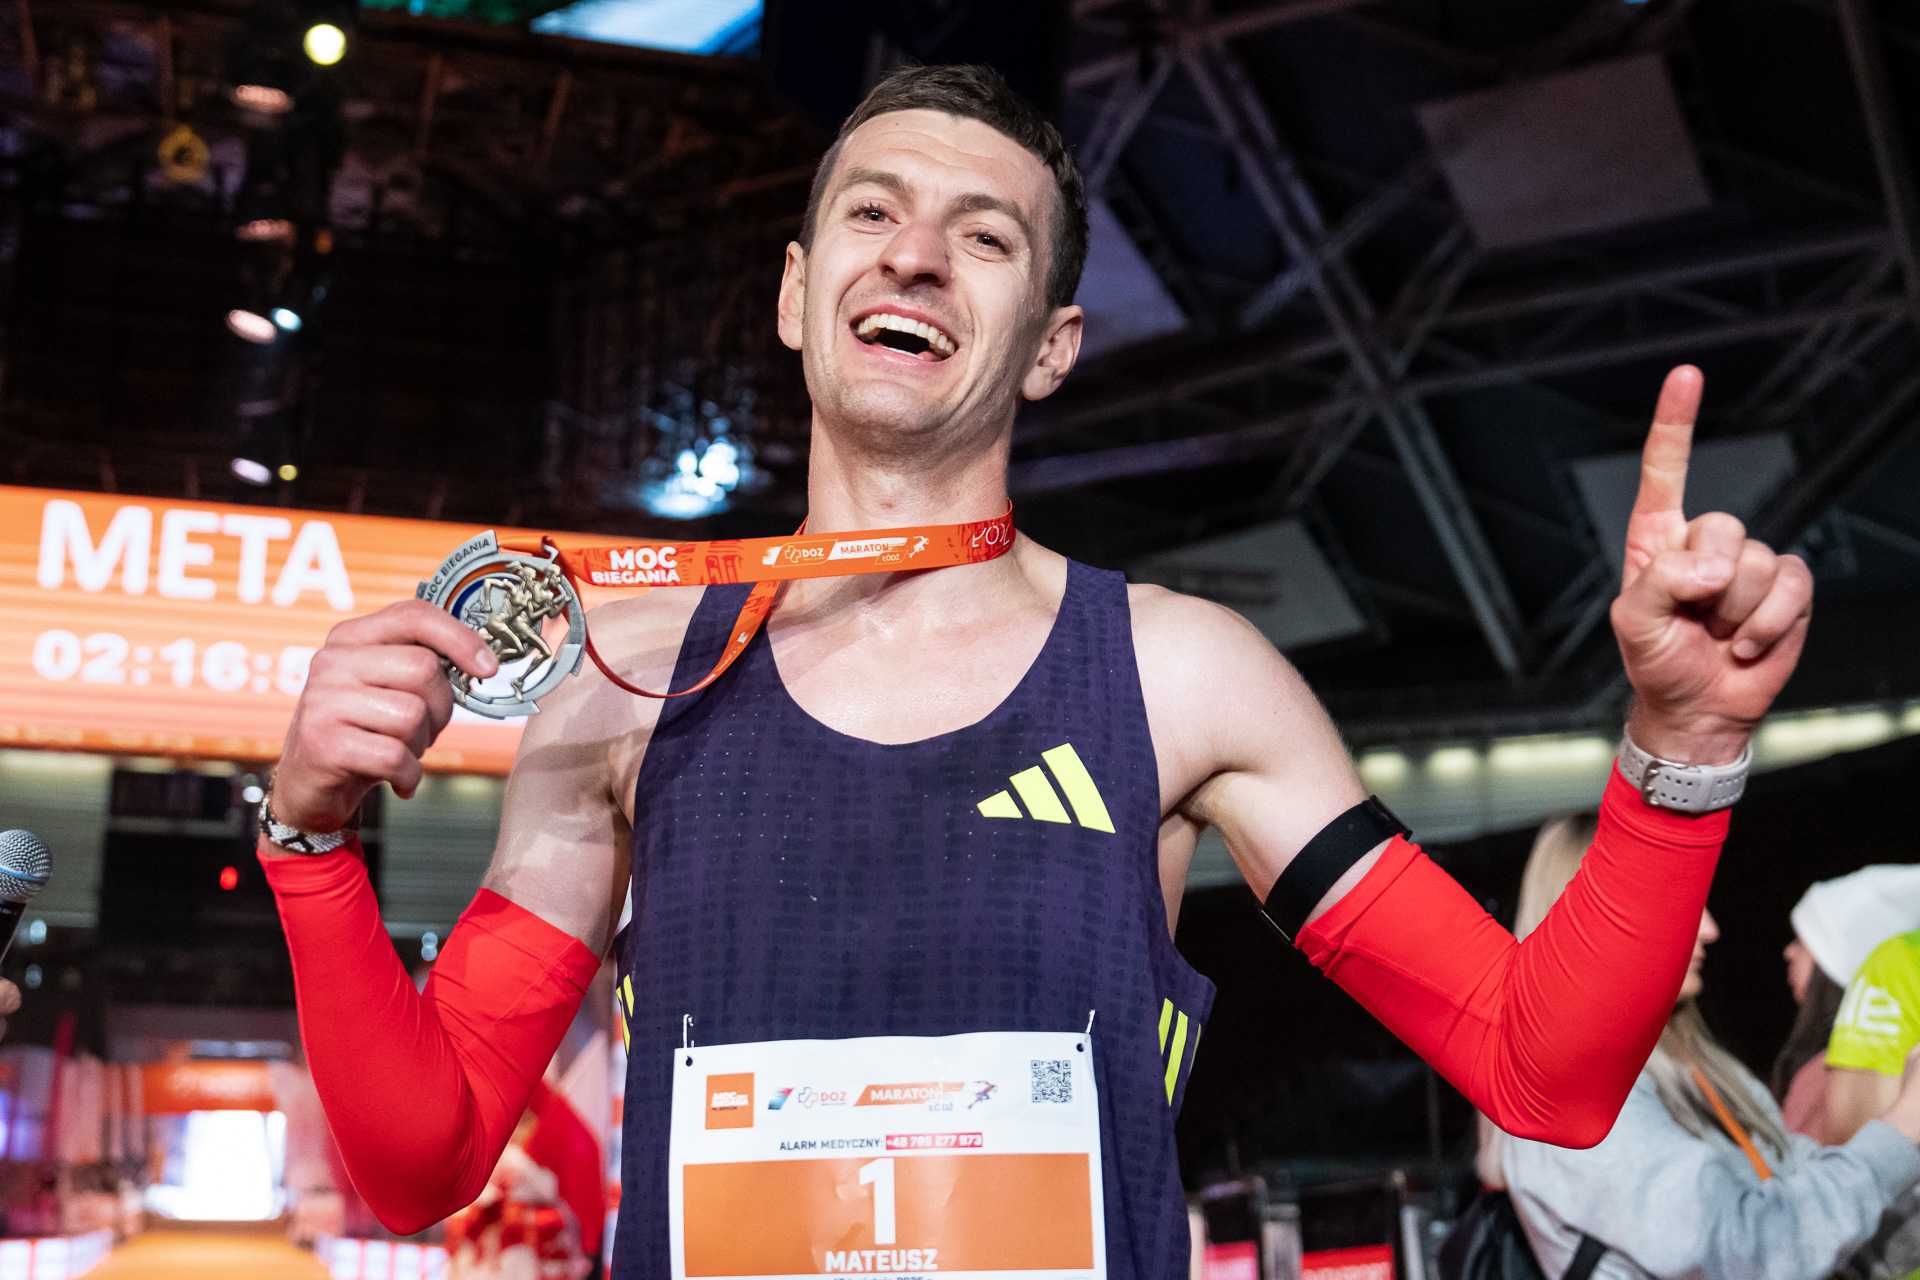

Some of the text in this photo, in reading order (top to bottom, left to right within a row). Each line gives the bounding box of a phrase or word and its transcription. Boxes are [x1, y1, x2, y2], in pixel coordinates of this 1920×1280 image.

[38, 499, 355, 611] META
[610, 546, 678, 570] MOC
[802, 543, 890, 558] DOZ MARATON
[426, 539, 490, 602] MOC BIEGANIA
[591, 569, 681, 584] BIEGANIA
[821, 1086, 941, 1102] DOZ MARATON
[779, 1140, 817, 1151] ALARM
[821, 1138, 884, 1149] MEDYCZNY:
[858, 1157, 896, 1245] 1
[825, 1249, 938, 1272] MATEUSZ
